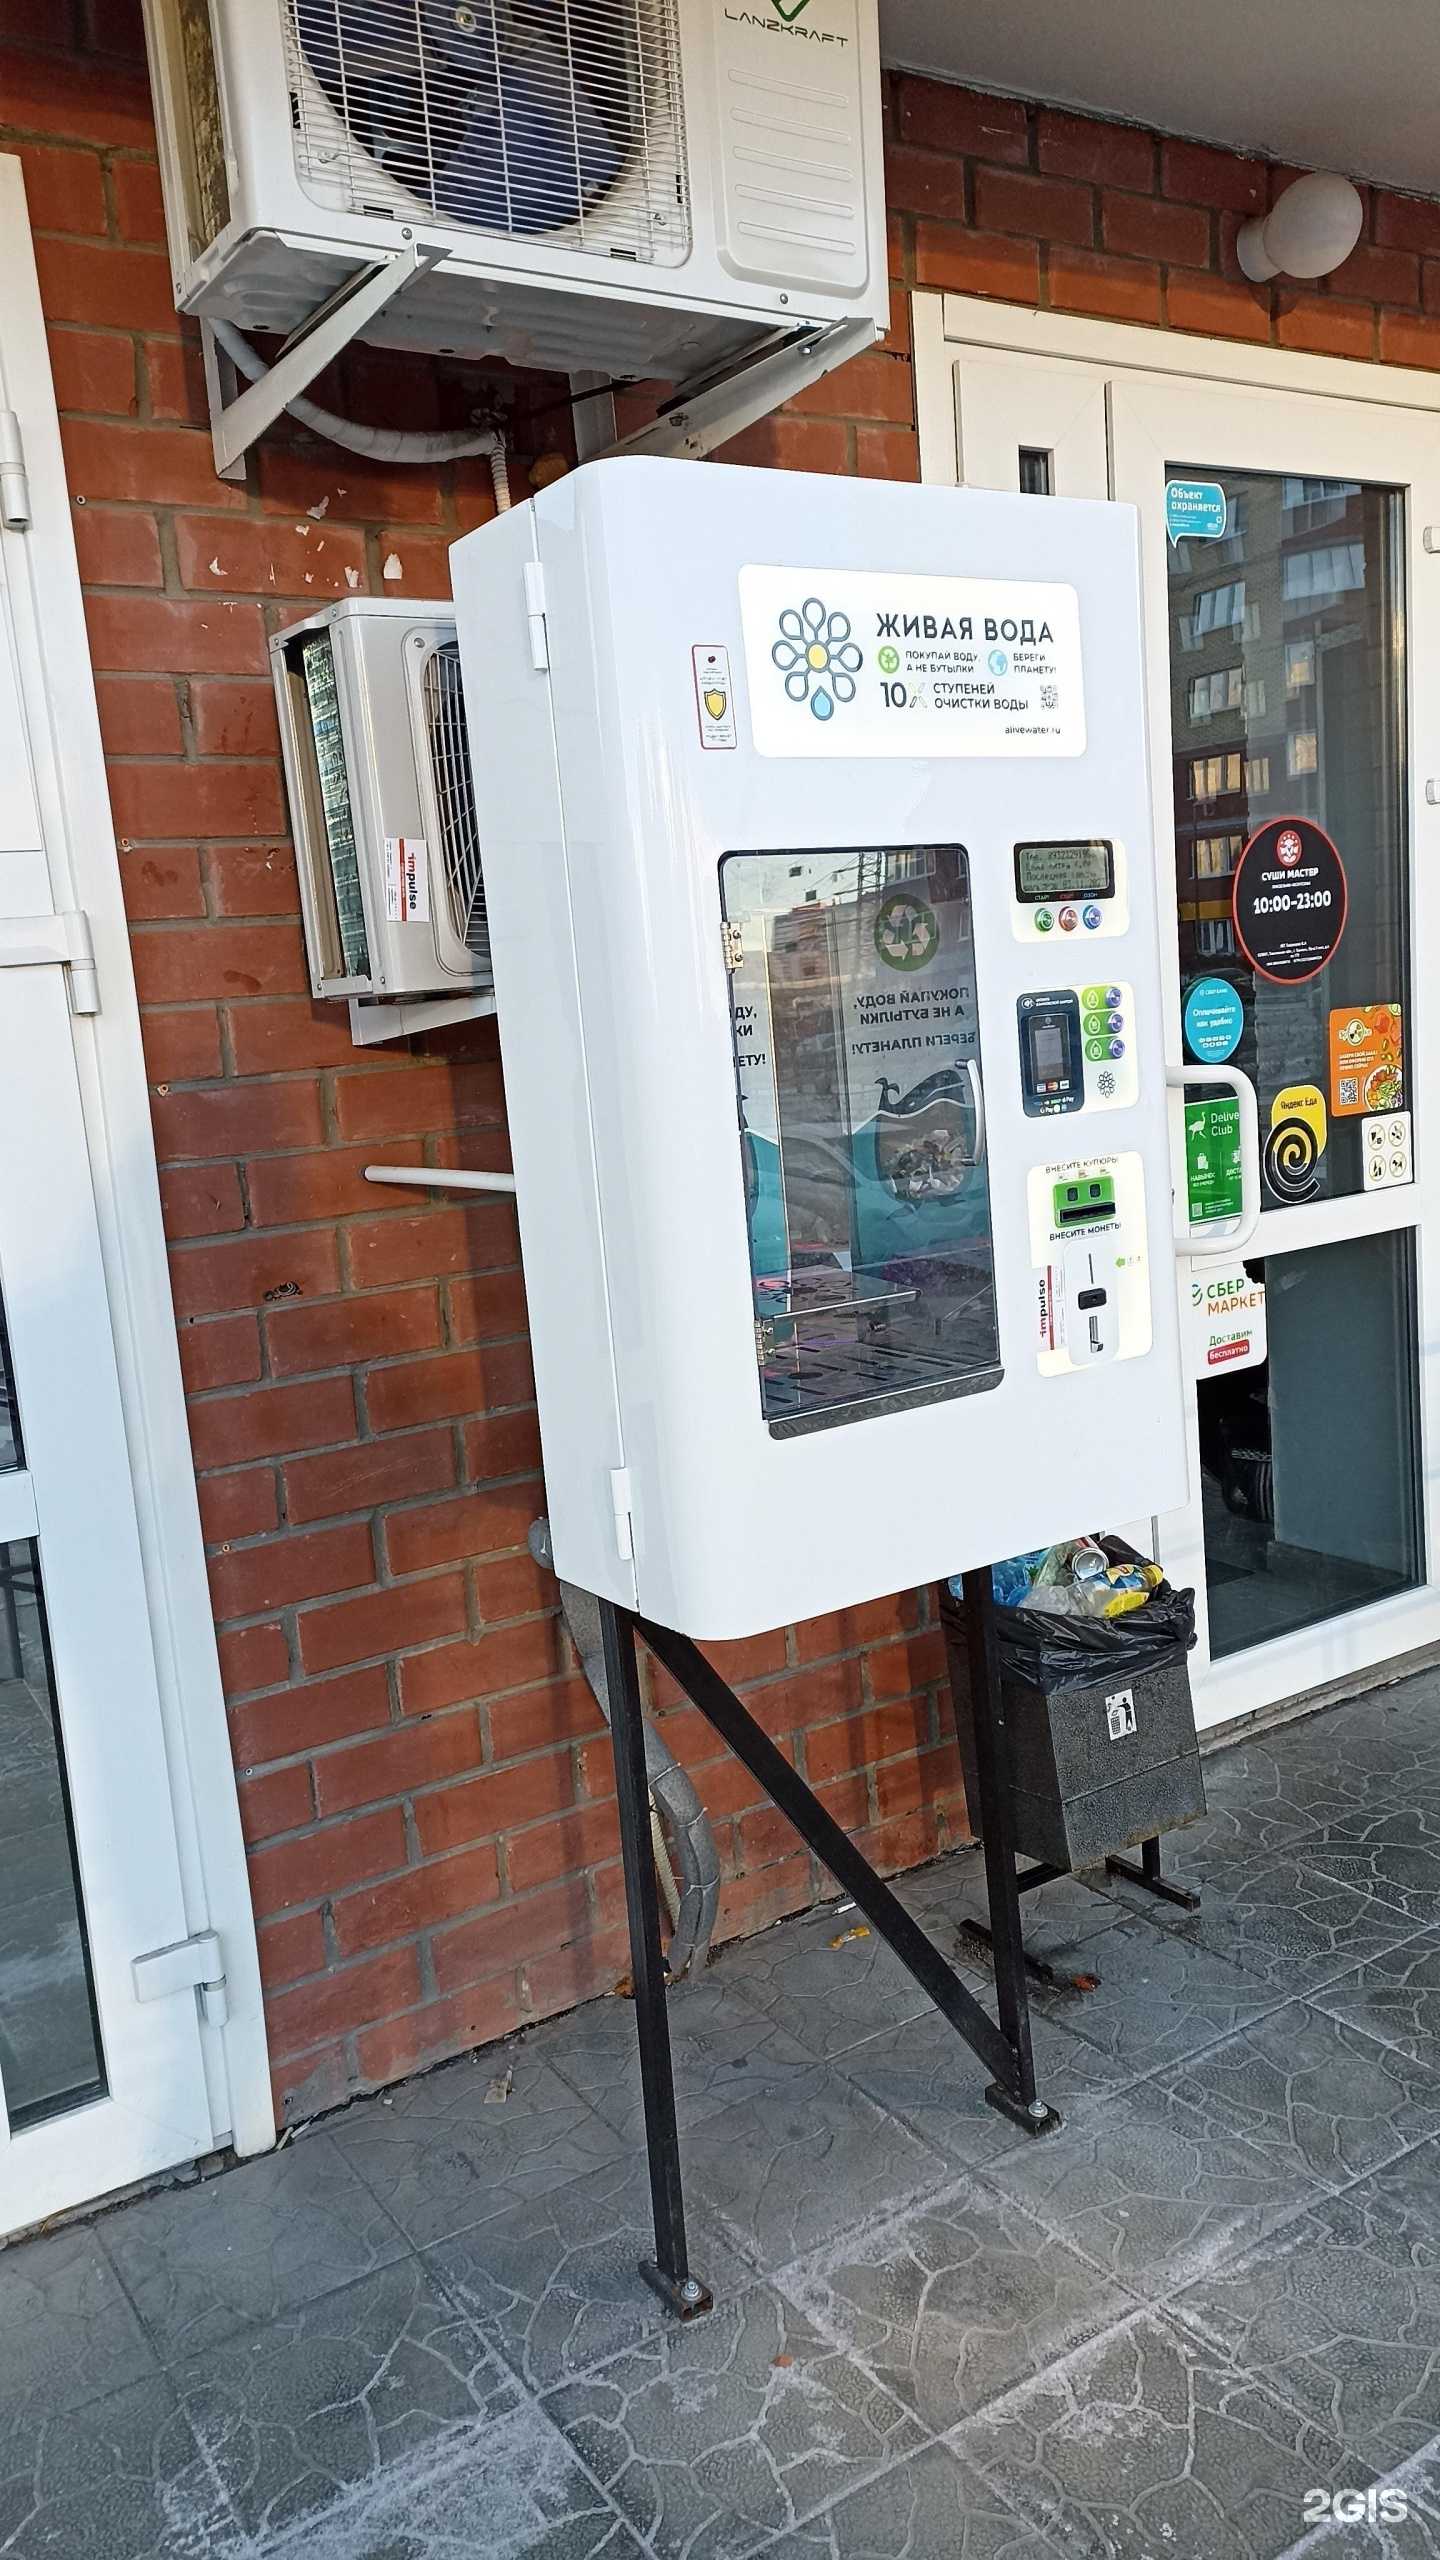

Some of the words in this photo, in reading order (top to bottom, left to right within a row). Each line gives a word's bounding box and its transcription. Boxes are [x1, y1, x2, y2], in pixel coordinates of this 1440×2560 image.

[1170, 487, 1203, 500] Объект
[1171, 501, 1221, 513] охраняется
[876, 612, 974, 641] ЖИВАЯ
[984, 617, 1054, 647] ВОДА
[905, 650, 951, 661] ПОКУПАЙ
[1013, 652, 1046, 662] БЕРЕГИ
[906, 663, 913, 672] А
[915, 664, 927, 673] НЕ
[930, 664, 974, 674] БУТЫЛКИ
[932, 681, 996, 695] СТУПЕНЕЙ
[934, 697, 991, 710] ОЧИСТКИ
[994, 698, 1029, 712] ВОДЫ
[405, 852, 418, 910] impulse
[1261, 870, 1286, 882] СУШИ
[1287, 867, 1319, 880] МАСТЕР
[1253, 890, 1332, 915] 10:00-23:00
[735, 1006, 757, 1020] ДУ,
[737, 1053, 766, 1068] ЕТУ!
[1280, 1099, 1303, 1110] Яндекс
[1305, 1097, 1318, 1107] Еда
[1210, 1110, 1240, 1124] Delive
[1211, 1124, 1234, 1137] Club
[1045, 1161, 1081, 1174] ВНЕСИТЕ
[1083, 1157, 1119, 1168] КУПЮРЫ
[1049, 1228, 1086, 1241] ВНЕСИТЕ
[1087, 1221, 1122, 1234] МОНЕТЫ
[1206, 1278, 1246, 1299] СБЕР
[1207, 1290, 1266, 1317] МАРКЕТ
[1209, 1329, 1253, 1346] Доставим
[1209, 1344, 1249, 1360] бесплатно
